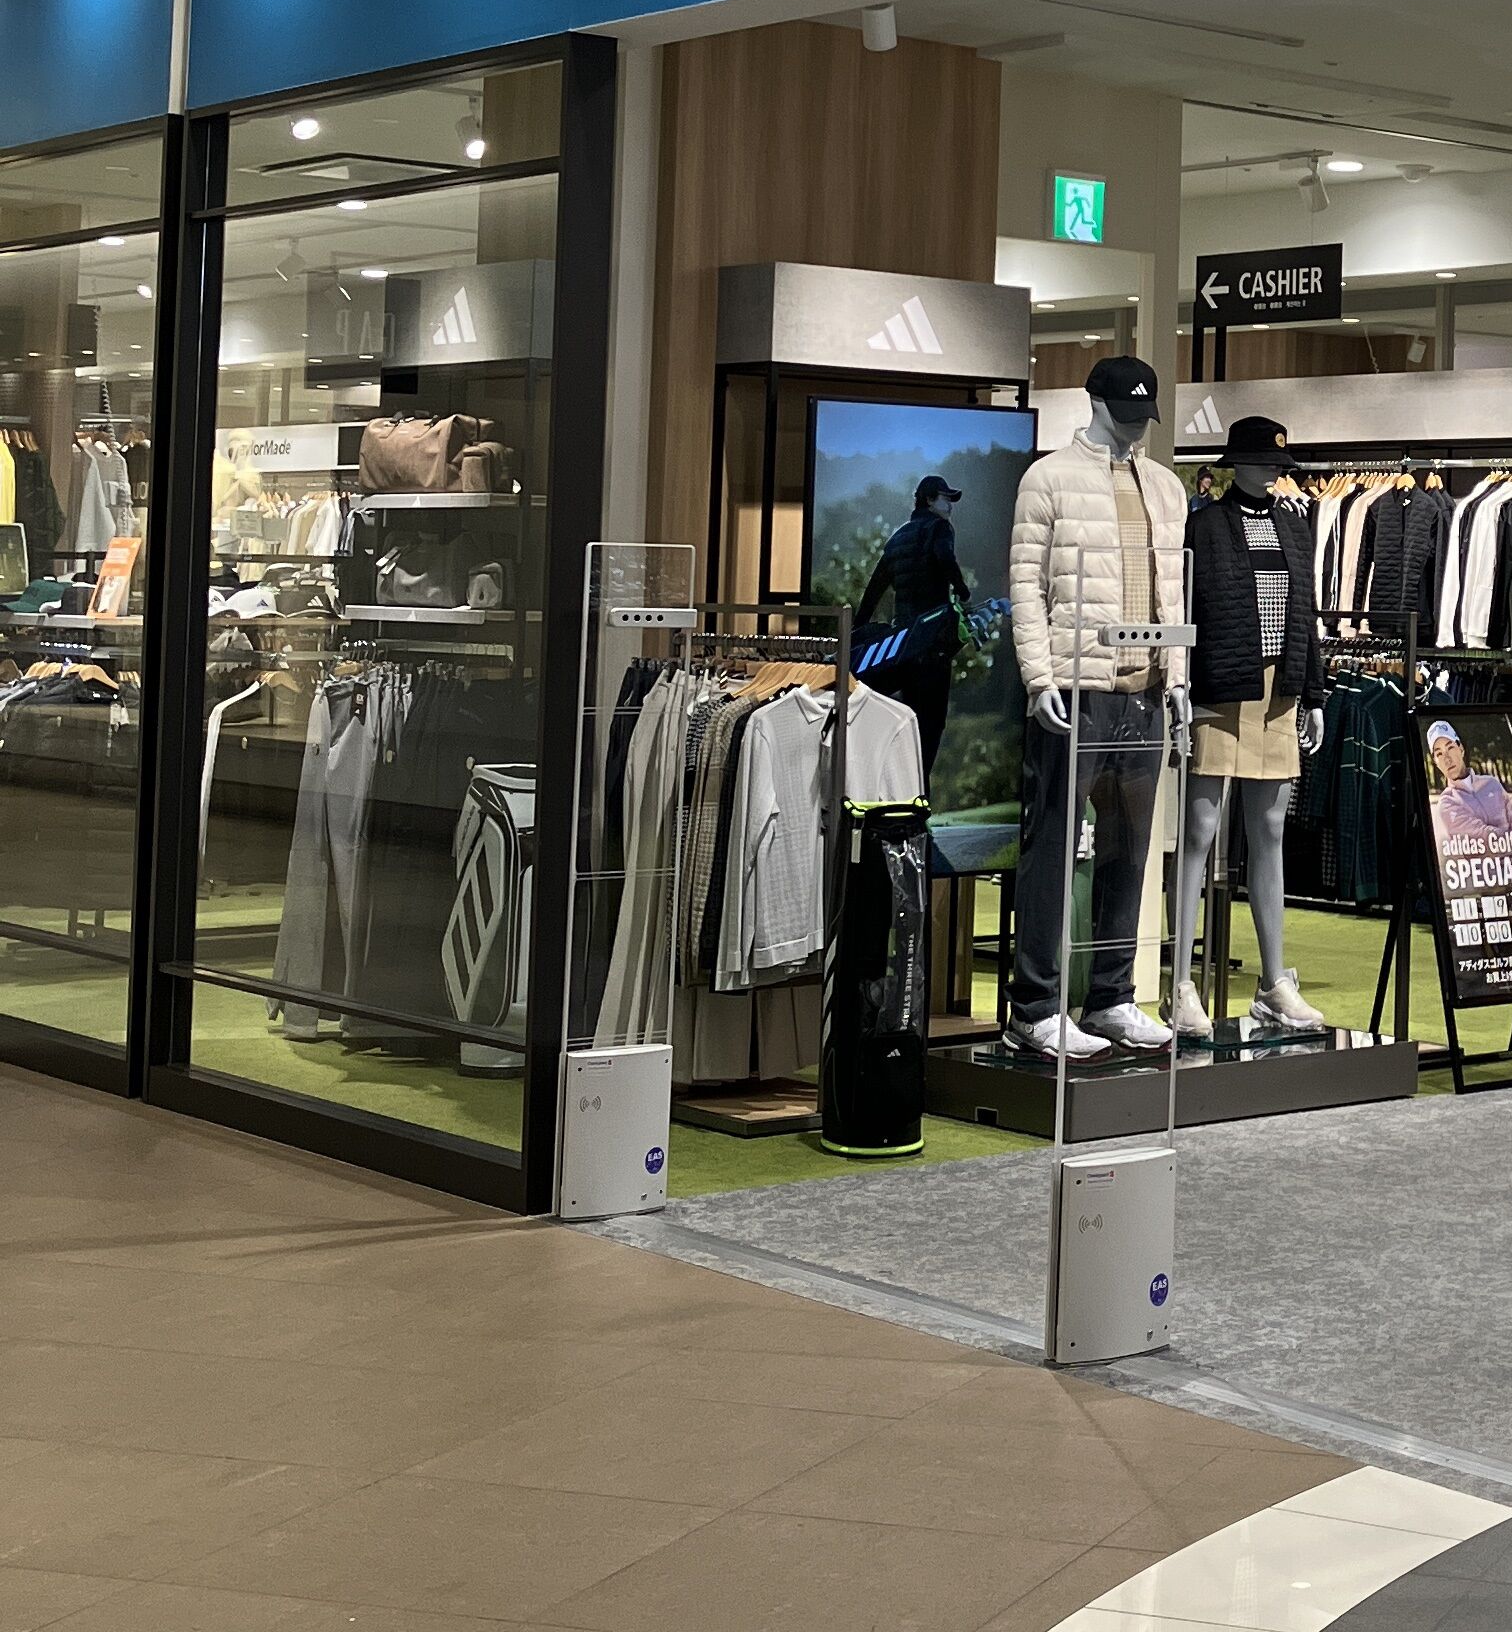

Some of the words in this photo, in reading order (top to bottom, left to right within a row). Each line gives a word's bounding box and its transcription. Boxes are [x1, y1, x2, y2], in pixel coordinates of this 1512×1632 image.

[1238, 265, 1323, 300] CASHIER
[1442, 832, 1485, 856] adidas
[647, 1150, 663, 1163] EAS
[1152, 1278, 1168, 1292] EAS
